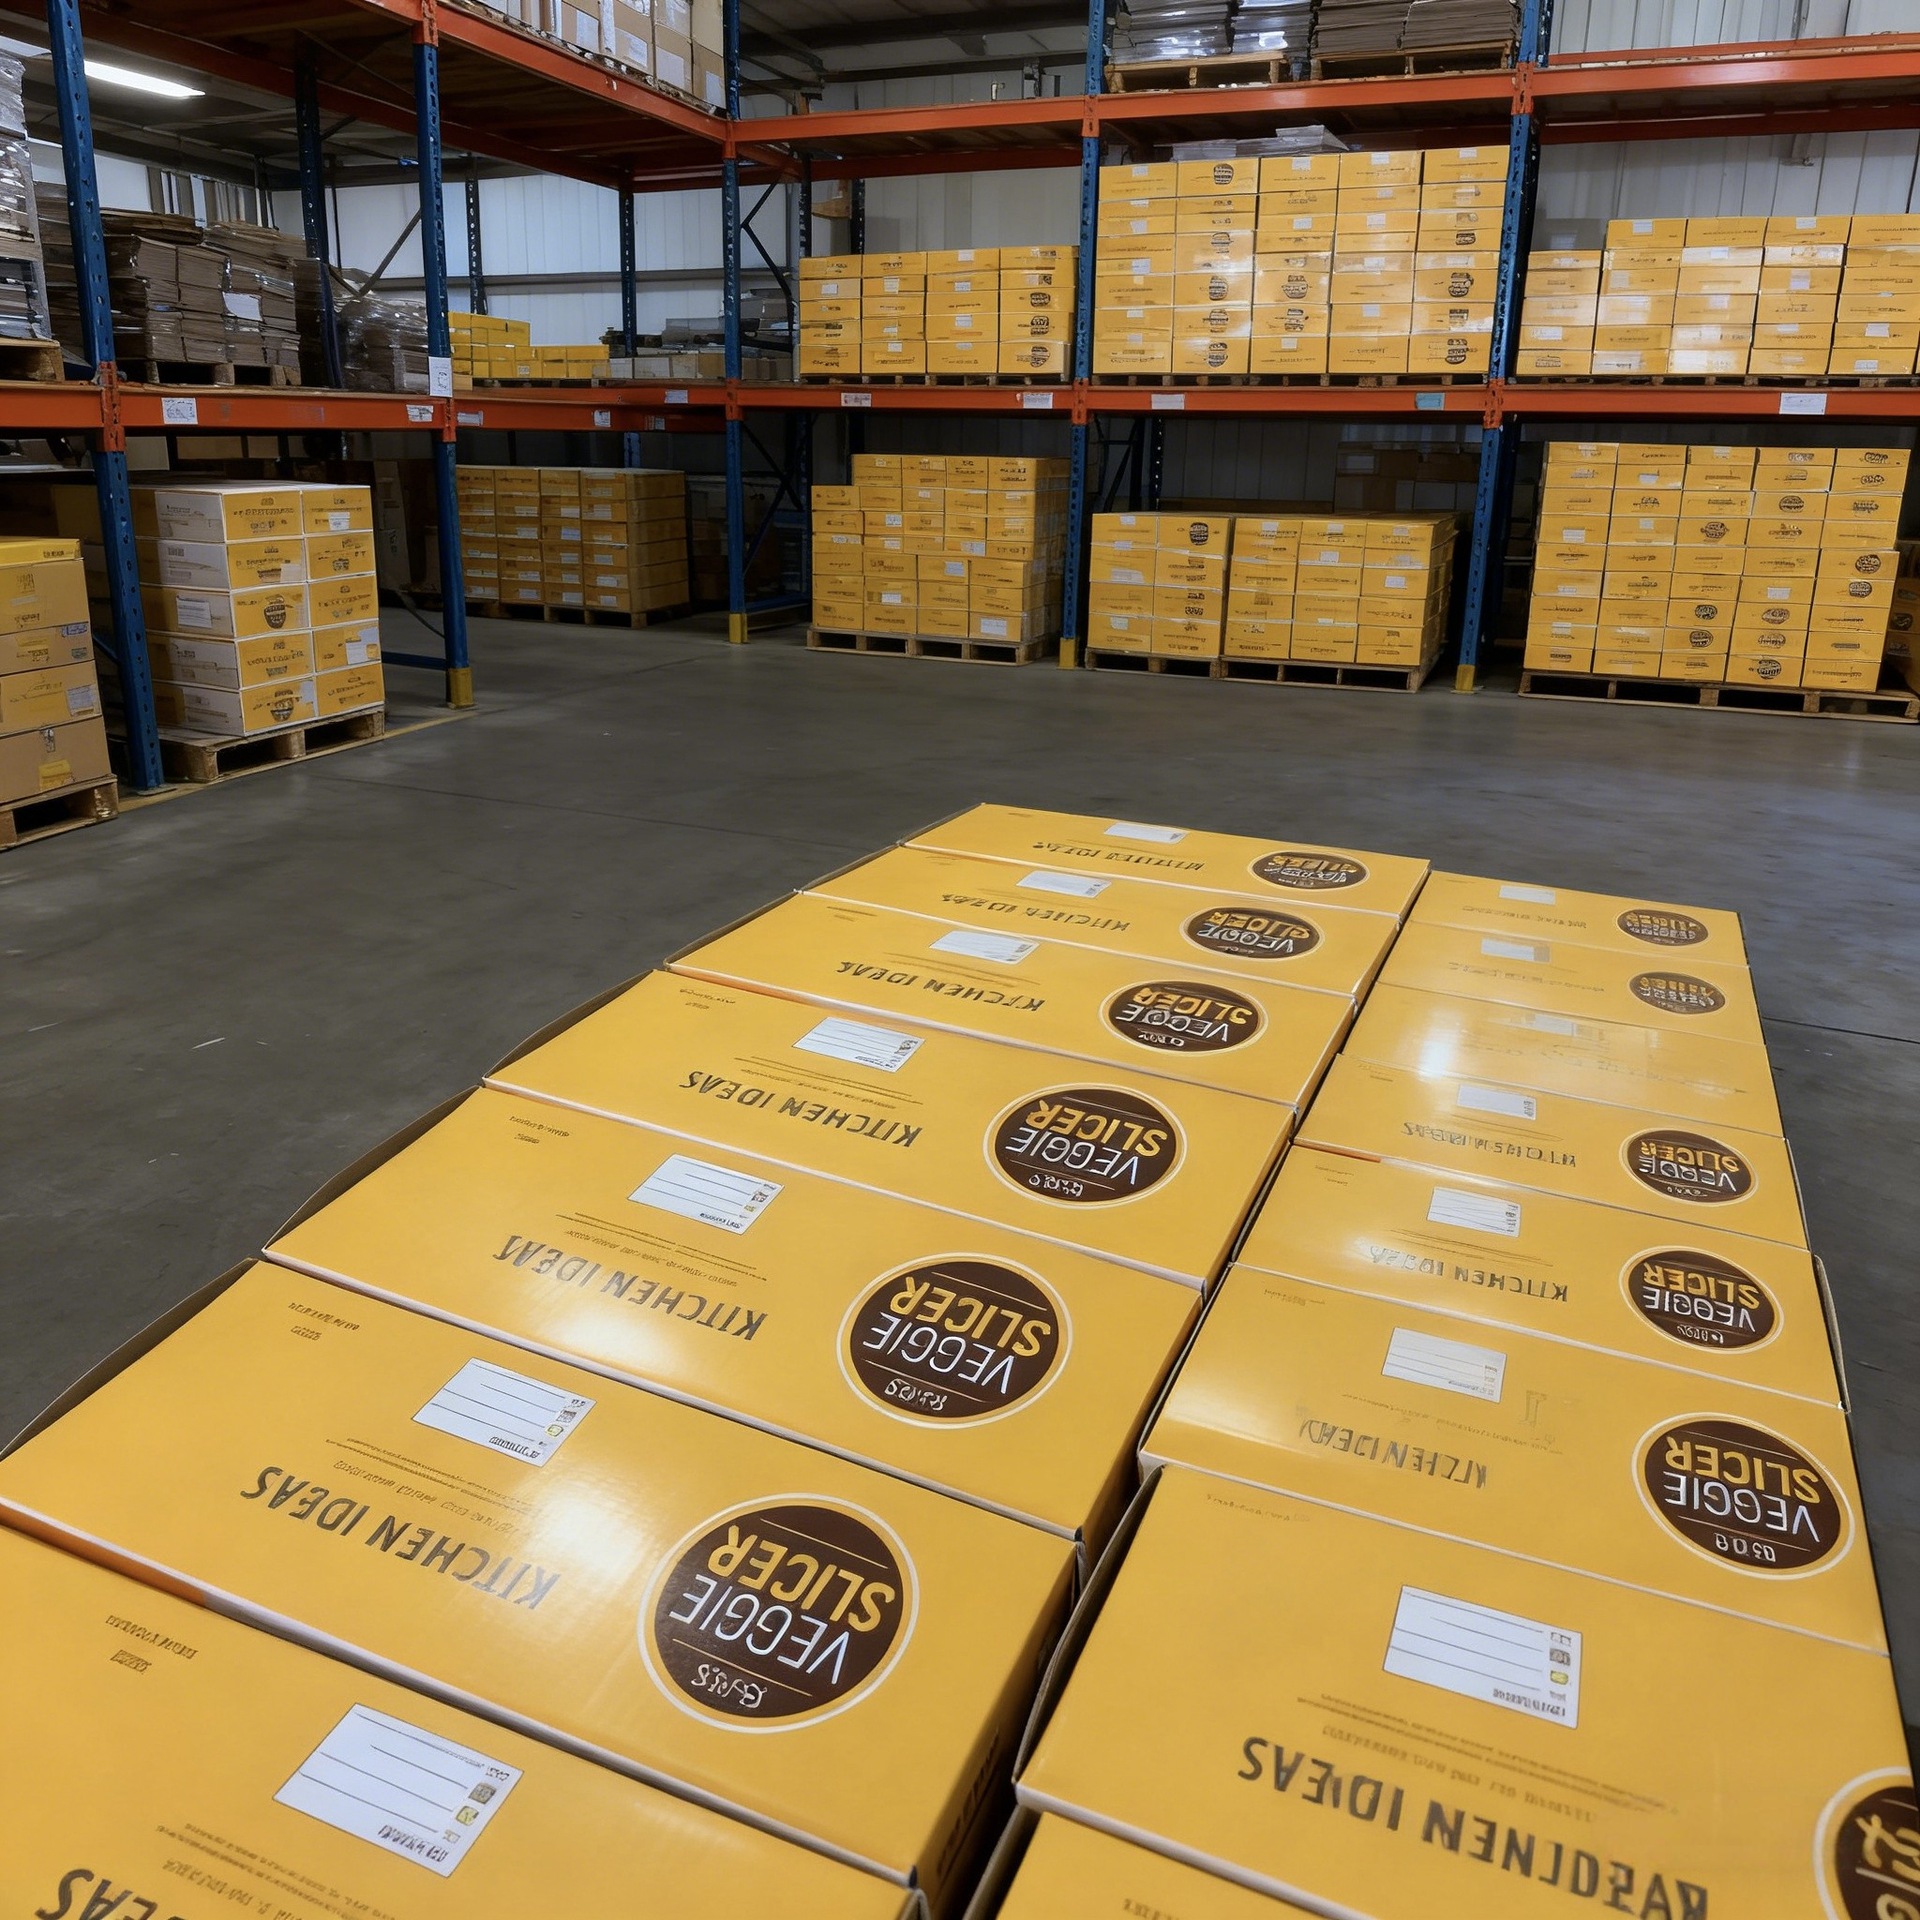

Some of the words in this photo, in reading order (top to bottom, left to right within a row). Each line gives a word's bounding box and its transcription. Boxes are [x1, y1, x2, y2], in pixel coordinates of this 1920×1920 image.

[679, 1070, 775, 1109] IDEAS
[778, 1096, 923, 1148] KITCHEN
[1005, 1127, 1139, 1185] VEGGIE
[1025, 1099, 1168, 1157] SLICER
[600, 1270, 768, 1341] KITCHEN
[890, 1276, 1051, 1357] SLICER
[1642, 1262, 1760, 1310] SLICER
[862, 1312, 1016, 1395] VEGGIE
[240, 1466, 371, 1537] IDEAS
[1664, 1436, 1821, 1504] SLICER
[1663, 1471, 1821, 1543] VEGGIE
[365, 1515, 561, 1611] KITCHEN
[707, 1525, 895, 1633] SLICER
[669, 1574, 850, 1685] VEGGIE
